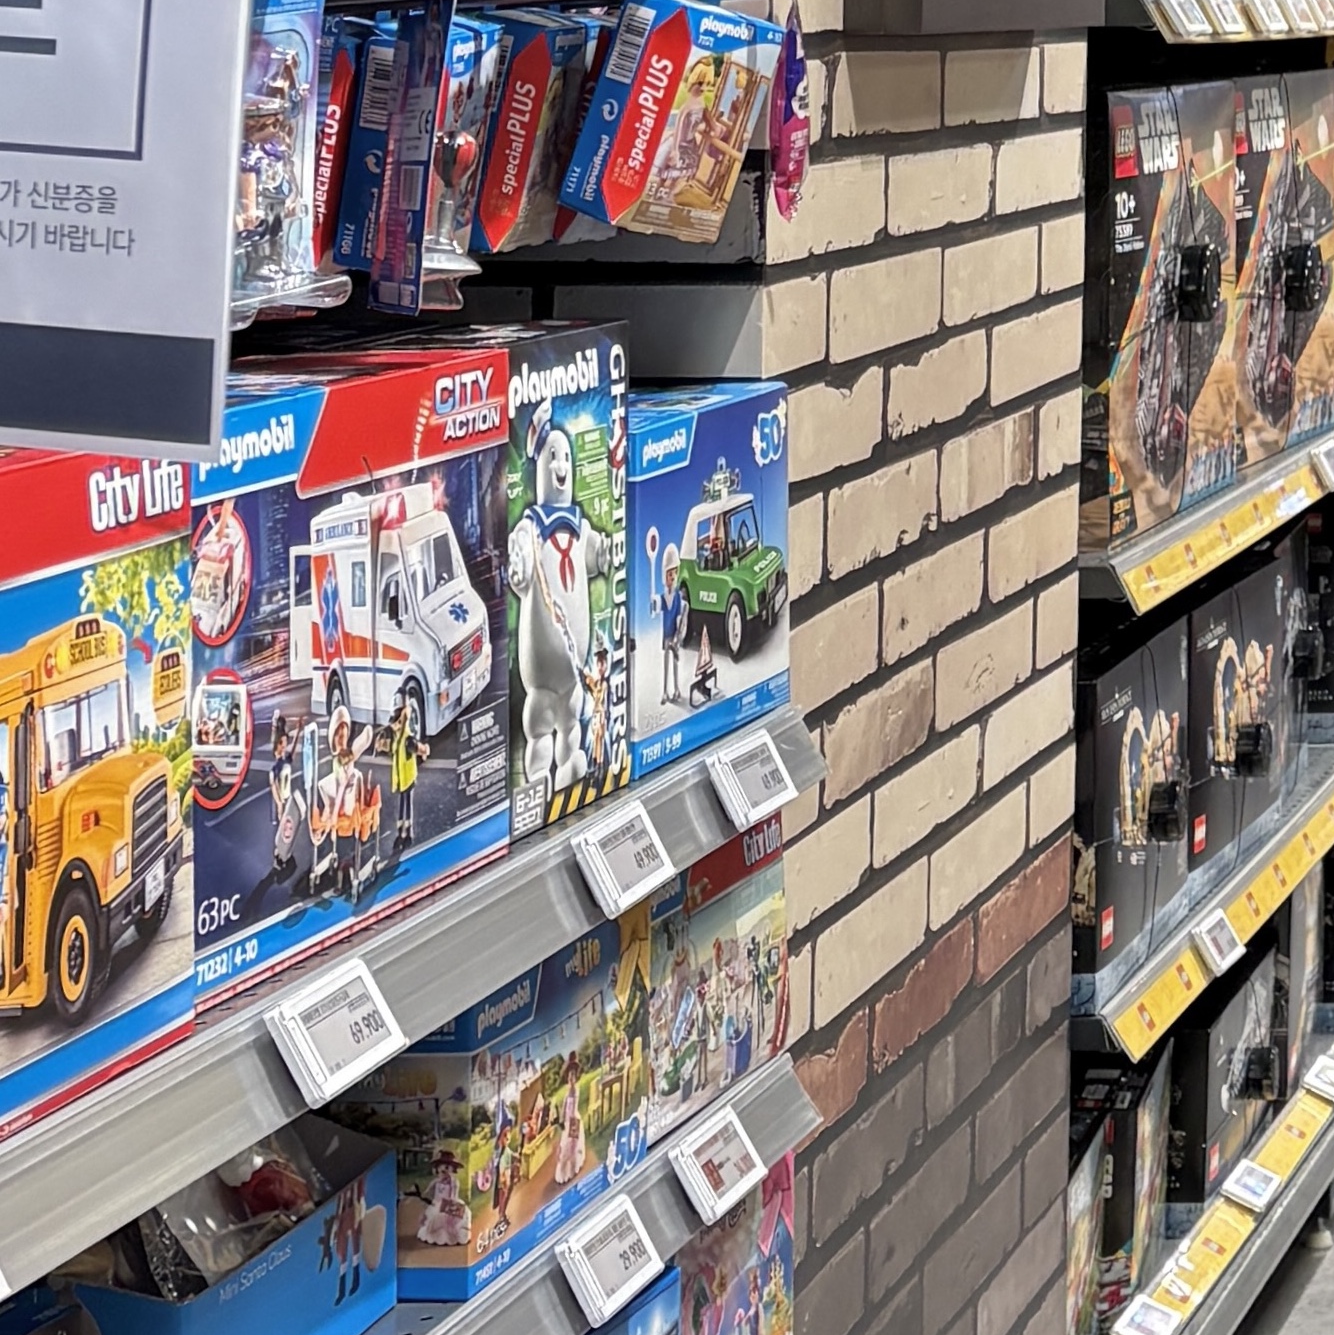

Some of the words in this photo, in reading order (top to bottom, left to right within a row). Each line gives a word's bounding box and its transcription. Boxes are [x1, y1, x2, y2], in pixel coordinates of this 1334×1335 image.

[627, 53, 674, 172] specialPLUS
[1139, 101, 1178, 137] STAR
[1248, 87, 1284, 121] STAR
[501, 80, 537, 196] specialPLUS
[1139, 134, 1180, 175] WARS
[1248, 120, 1286, 155] WARS
[26, 183, 118, 216] 신분증을
[1115, 191, 1136, 220] 10+
[43, 225, 136, 258] 바랍니다
[434, 366, 495, 416] CITY
[508, 347, 600, 419] playmobil
[441, 406, 501, 442] ACTION
[758, 412, 784, 465] 50
[199, 413, 295, 483] aymobil
[642, 427, 687, 469] playmobil
[89, 465, 140, 533] City
[142, 458, 184, 517] Life
[69, 636, 93, 666] SCHOOL
[742, 832, 764, 866] City
[764, 818, 781, 857] Life
[476, 977, 531, 1039] playmobil
